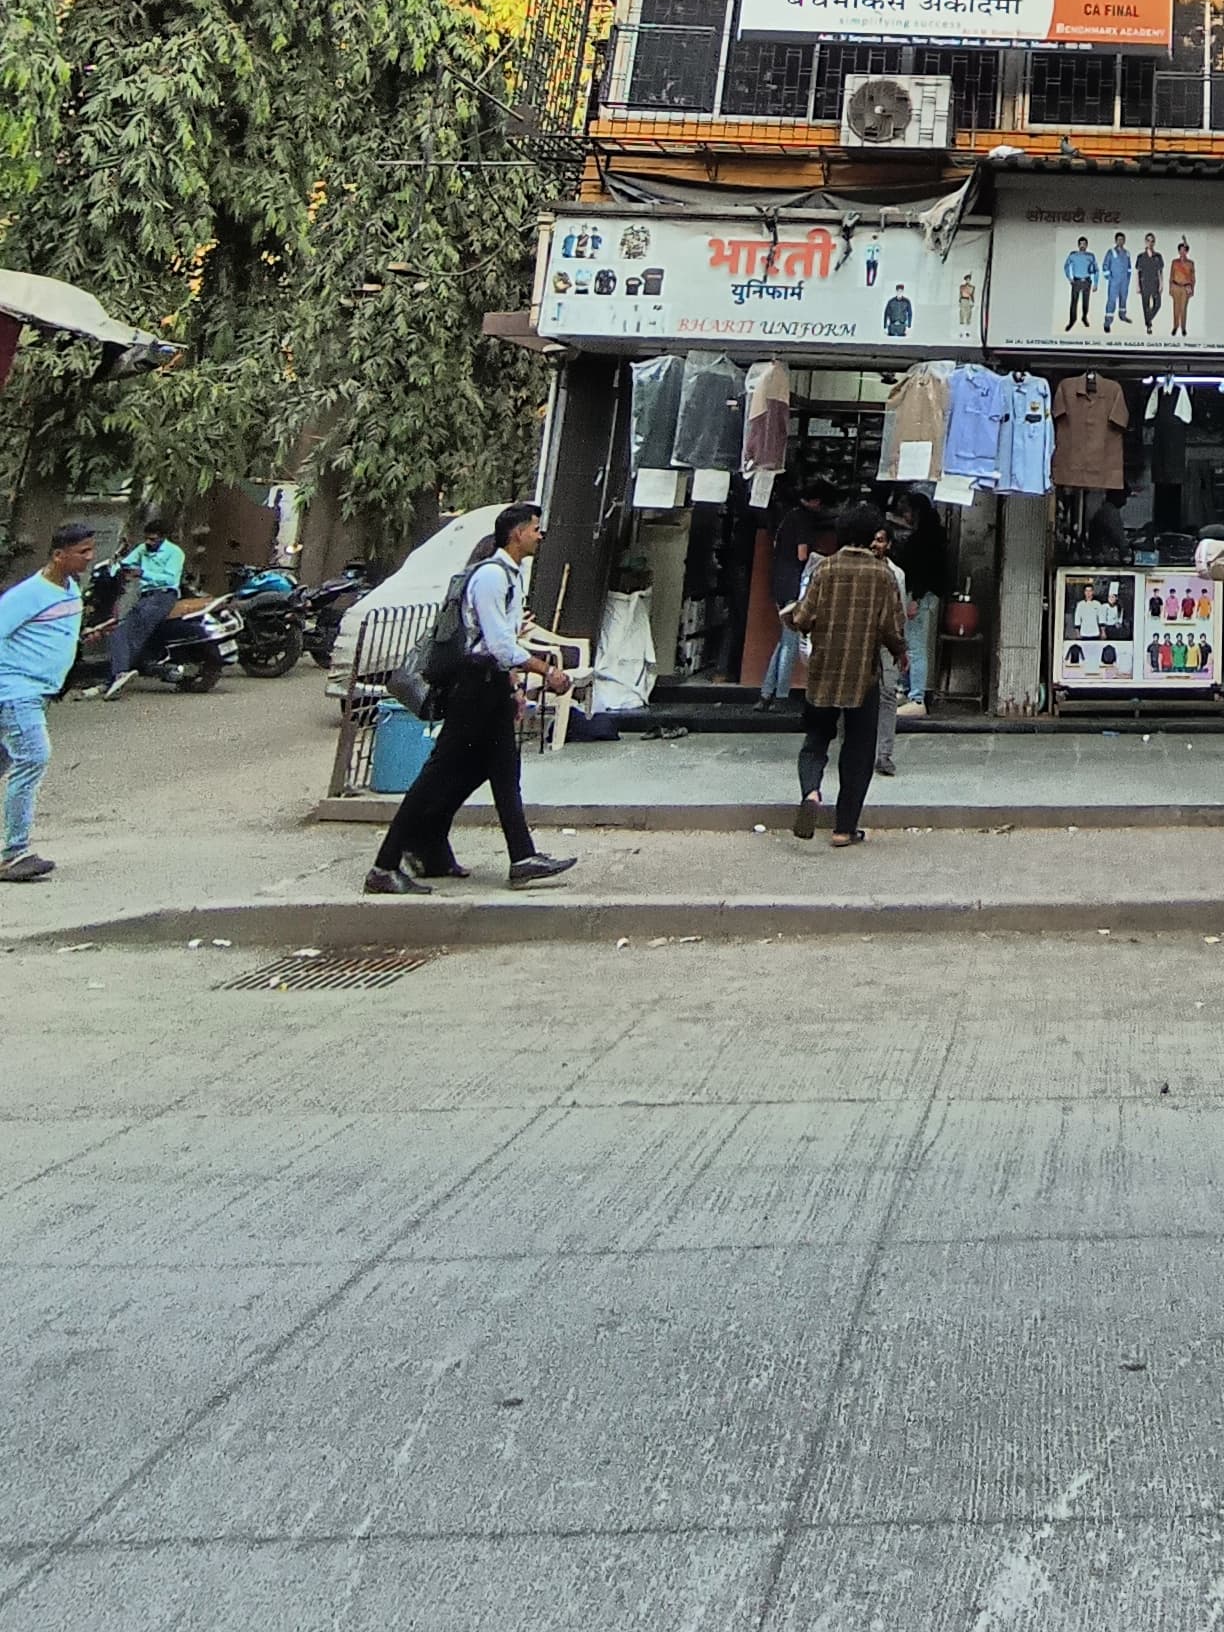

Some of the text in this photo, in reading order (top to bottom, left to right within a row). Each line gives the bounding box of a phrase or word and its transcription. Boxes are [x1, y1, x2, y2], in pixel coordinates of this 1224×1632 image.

[1084, 3, 1140, 18] CA FINAL
[708, 227, 837, 279] भारती
[677, 318, 857, 338] BHARTI UNIFORM
